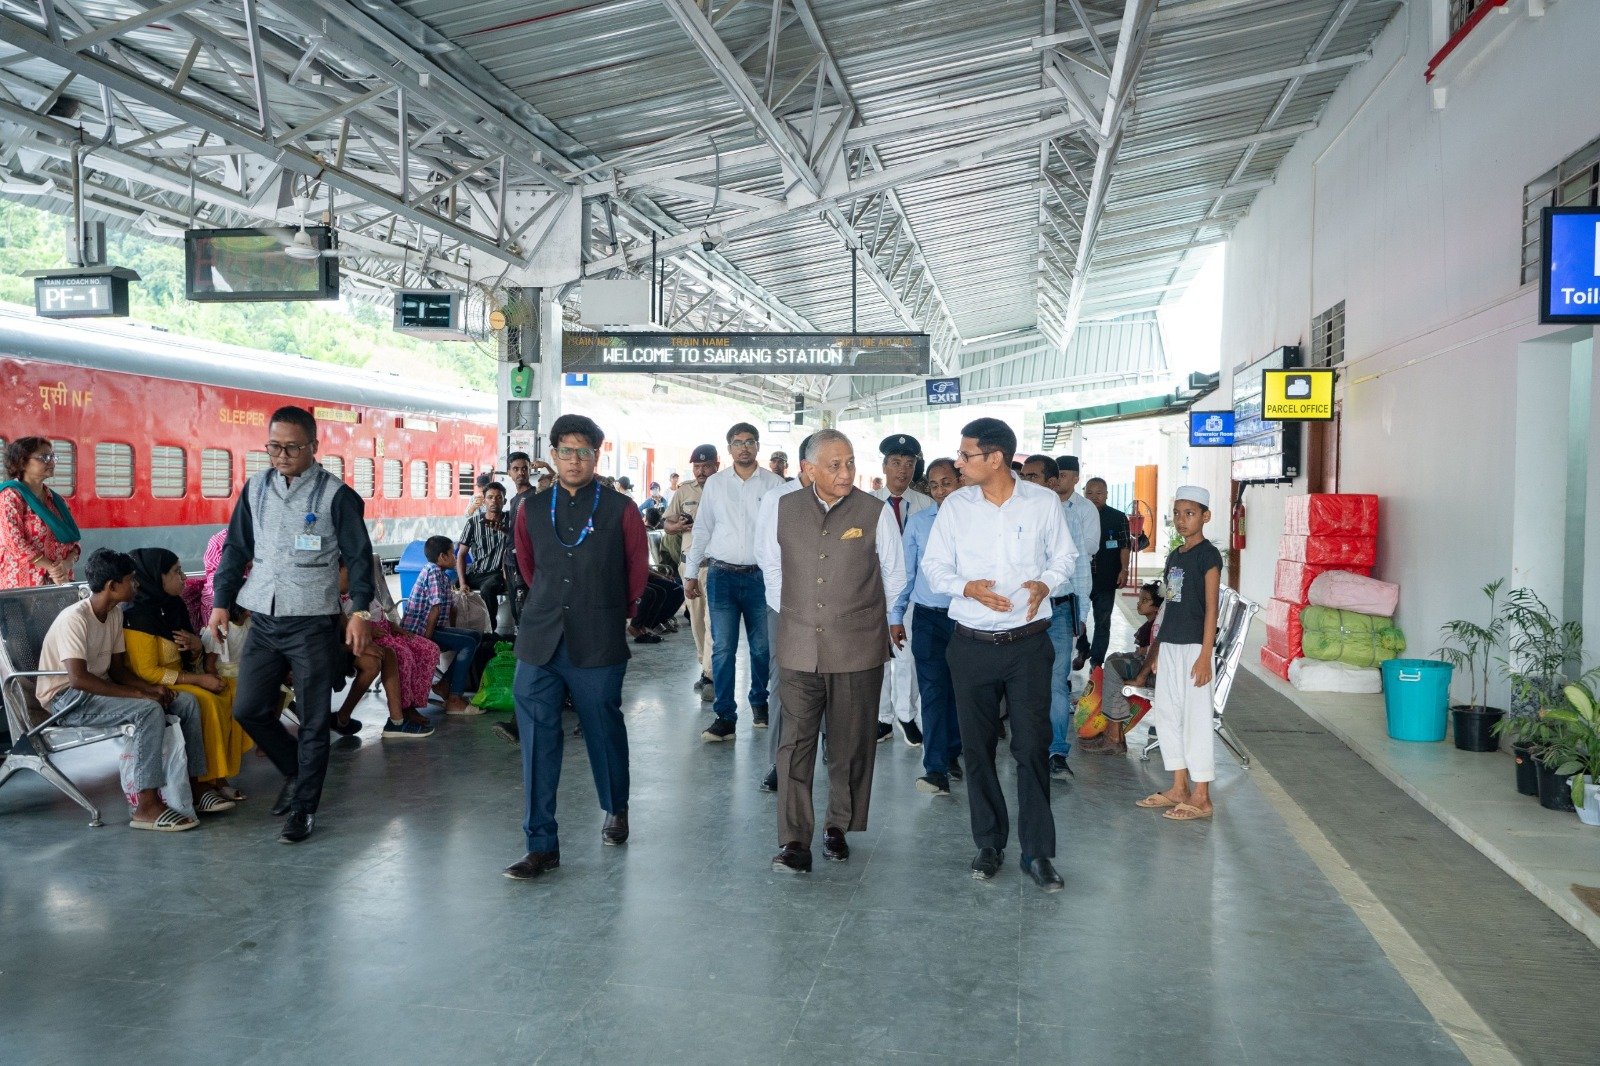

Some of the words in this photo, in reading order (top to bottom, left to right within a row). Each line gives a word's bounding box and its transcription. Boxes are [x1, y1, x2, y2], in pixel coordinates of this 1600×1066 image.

[45, 287, 98, 309] PF-1
[672, 337, 699, 347] TRAIN
[702, 337, 730, 347] NAME
[603, 348, 674, 363] WELCOME
[679, 348, 700, 363] TO
[704, 348, 772, 363] SAIRANG
[776, 348, 843, 364] STATION
[929, 393, 959, 402] EXIT
[1267, 404, 1298, 414] PARCEL
[1300, 404, 1329, 413] OFFICE
[219, 408, 265, 426] SLEEPER
